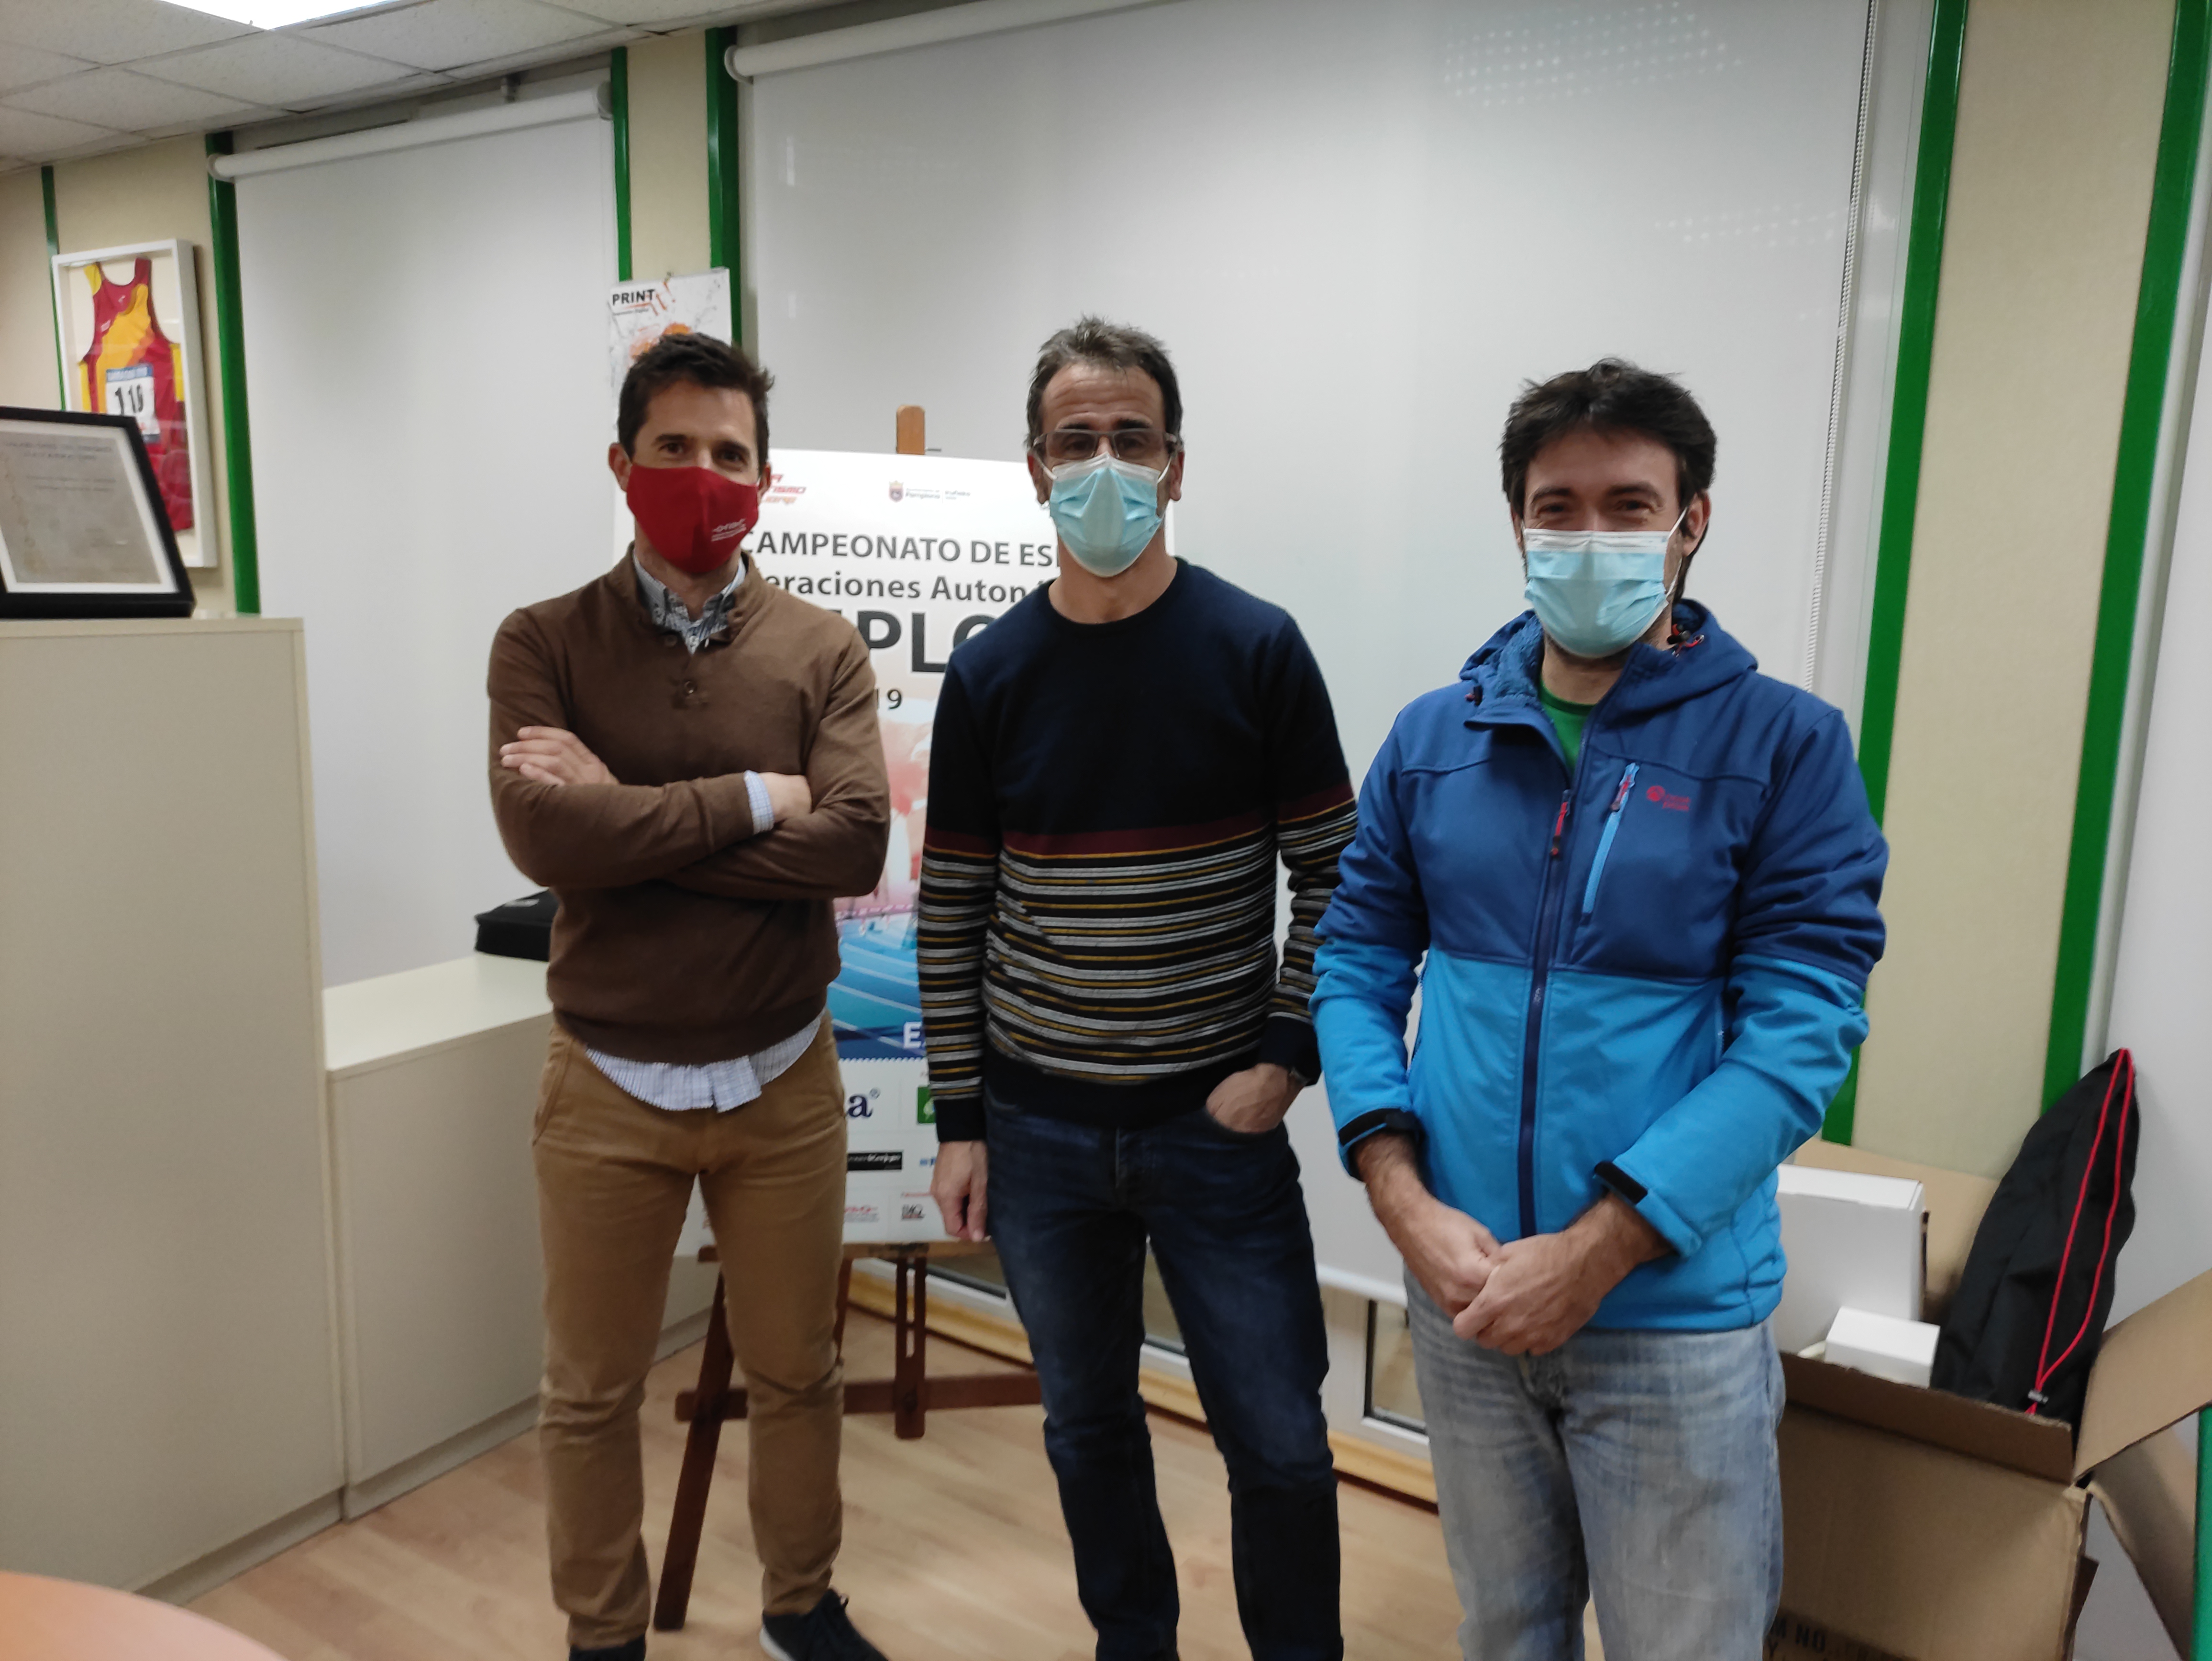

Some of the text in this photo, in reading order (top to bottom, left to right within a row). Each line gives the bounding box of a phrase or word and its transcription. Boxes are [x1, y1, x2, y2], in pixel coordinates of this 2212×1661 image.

[612, 288, 655, 306] PRINT
[971, 540, 1009, 564] DE
[1020, 543, 1061, 568] ES
[930, 576, 1043, 603] Auton
